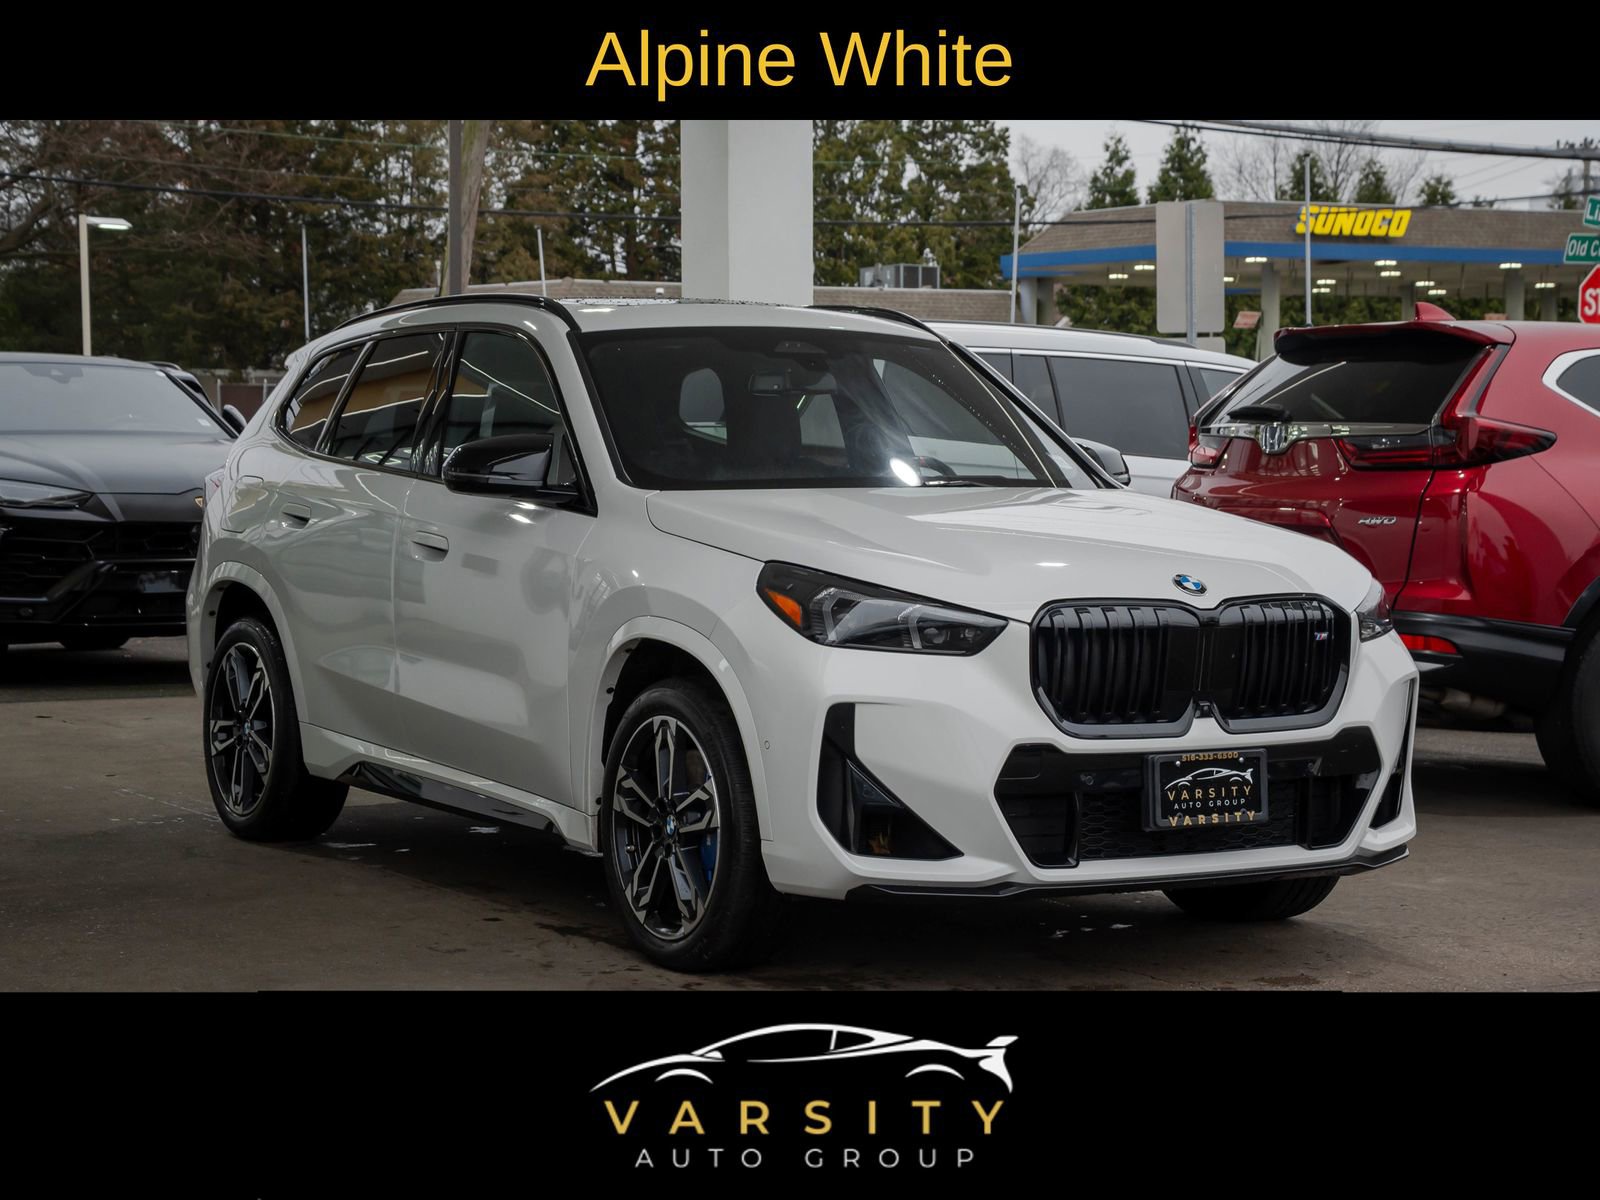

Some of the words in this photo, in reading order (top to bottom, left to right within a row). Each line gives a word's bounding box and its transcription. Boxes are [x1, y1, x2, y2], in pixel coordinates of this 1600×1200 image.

[1586, 203, 1600, 220] Li
[1296, 205, 1412, 238] SUNOCO
[1568, 239, 1588, 256] Old
[1590, 240, 1600, 256] C
[1168, 785, 1251, 801] VARSITY
[1174, 801, 1201, 810] AUTO
[1209, 798, 1246, 807] GROUP
[1169, 811, 1255, 827] VARSITY
